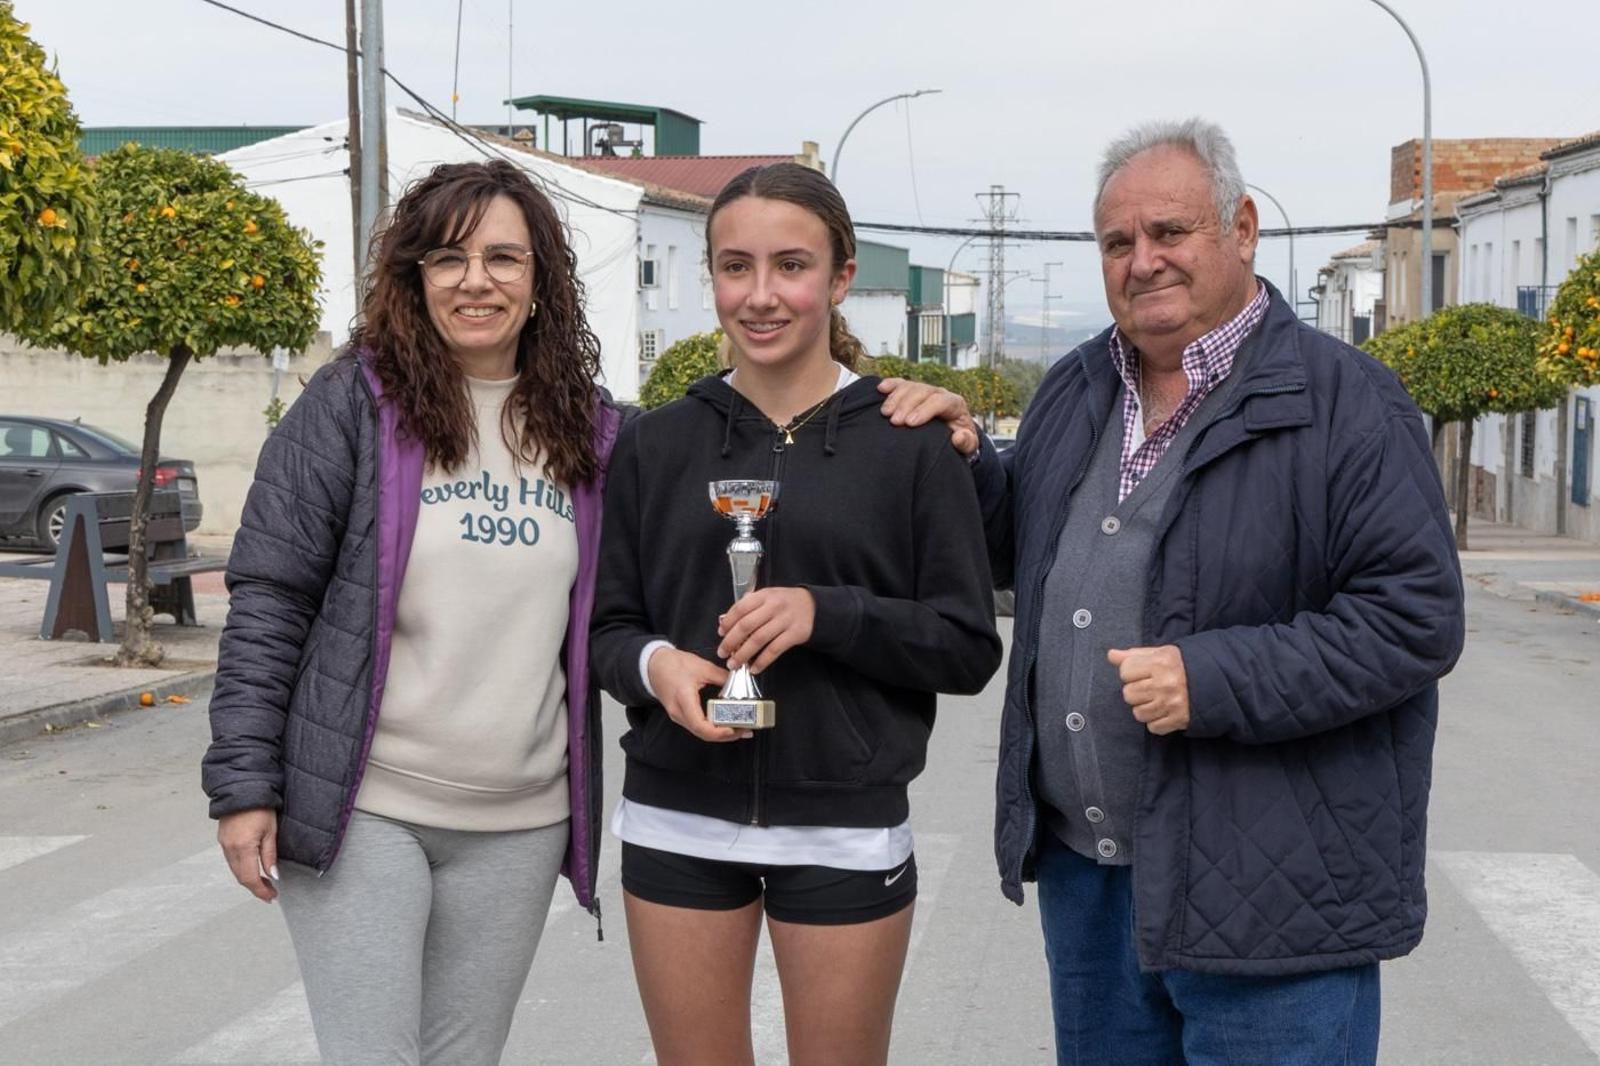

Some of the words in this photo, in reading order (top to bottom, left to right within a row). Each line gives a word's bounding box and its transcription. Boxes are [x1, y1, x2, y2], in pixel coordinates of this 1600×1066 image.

[420, 471, 509, 512] everly
[519, 477, 575, 523] Hills
[459, 512, 540, 546] 1990
